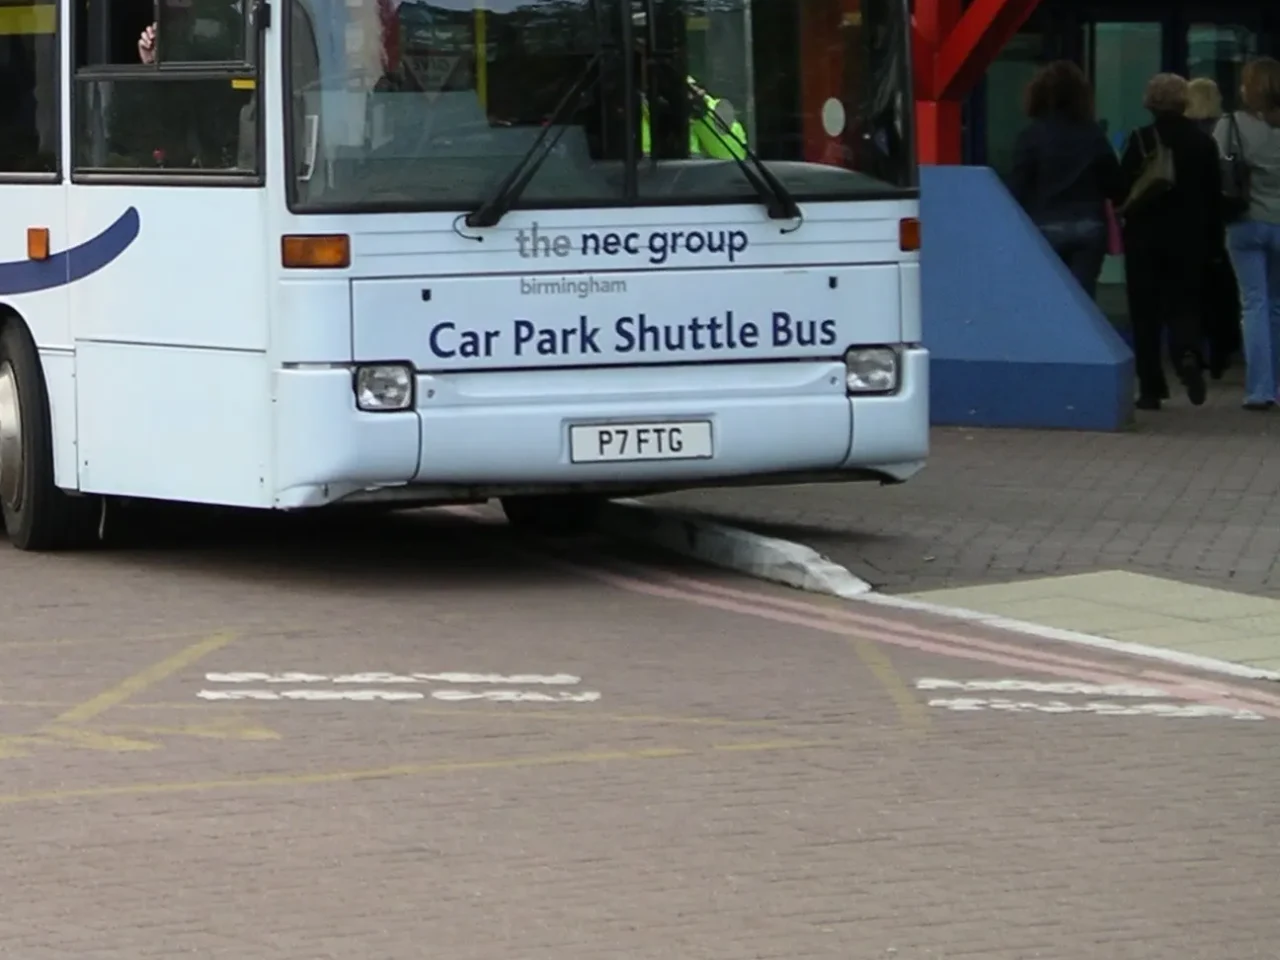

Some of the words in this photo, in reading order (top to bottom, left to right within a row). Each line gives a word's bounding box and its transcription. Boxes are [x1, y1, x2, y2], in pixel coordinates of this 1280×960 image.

[515, 221, 571, 258] the
[581, 231, 640, 256] nec
[648, 229, 749, 264] group
[520, 275, 627, 299] birmingham
[429, 321, 501, 359] Car
[513, 315, 602, 357] Park
[614, 310, 759, 353] Shuttle
[772, 311, 837, 348] Bus
[598, 429, 628, 456] P7
[636, 427, 683, 454] FTG
